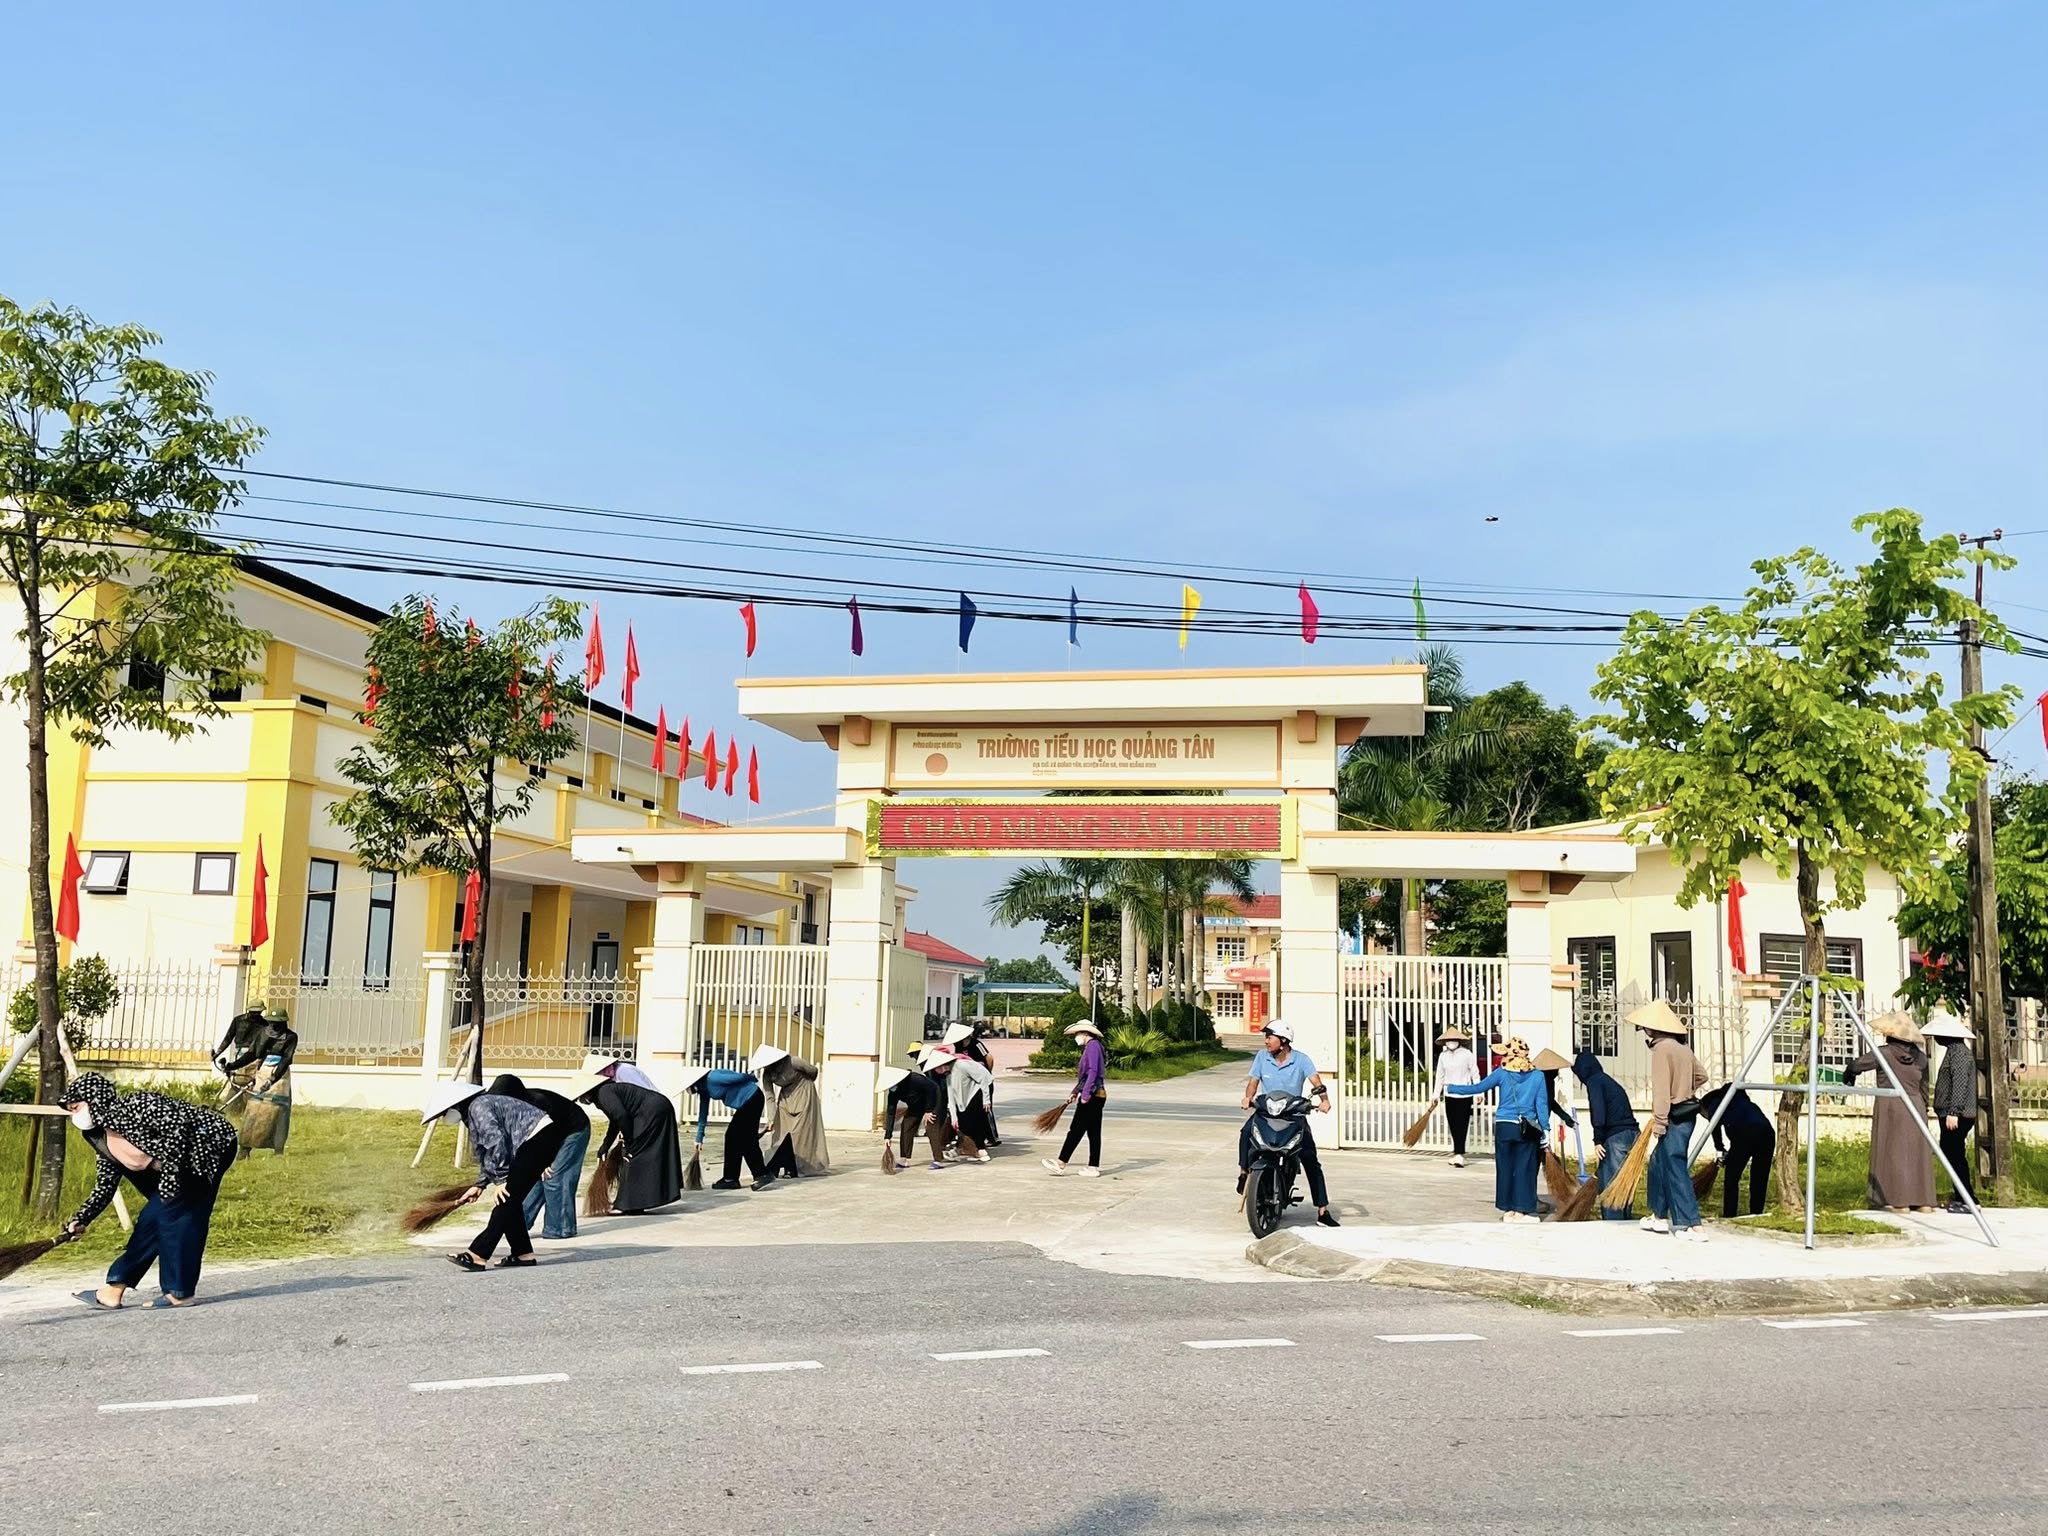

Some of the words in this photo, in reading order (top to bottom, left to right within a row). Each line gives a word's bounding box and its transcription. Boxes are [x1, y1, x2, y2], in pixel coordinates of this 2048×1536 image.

[977, 734, 1040, 758] TRƯỜNG
[1084, 738, 1117, 762] HỌC
[1122, 730, 1178, 760] QUẢNG
[1183, 733, 1215, 759] TÂN
[903, 808, 992, 839] CHÀO
[1001, 808, 1099, 839] MỪNG
[1196, 815, 1265, 845] HỌC
